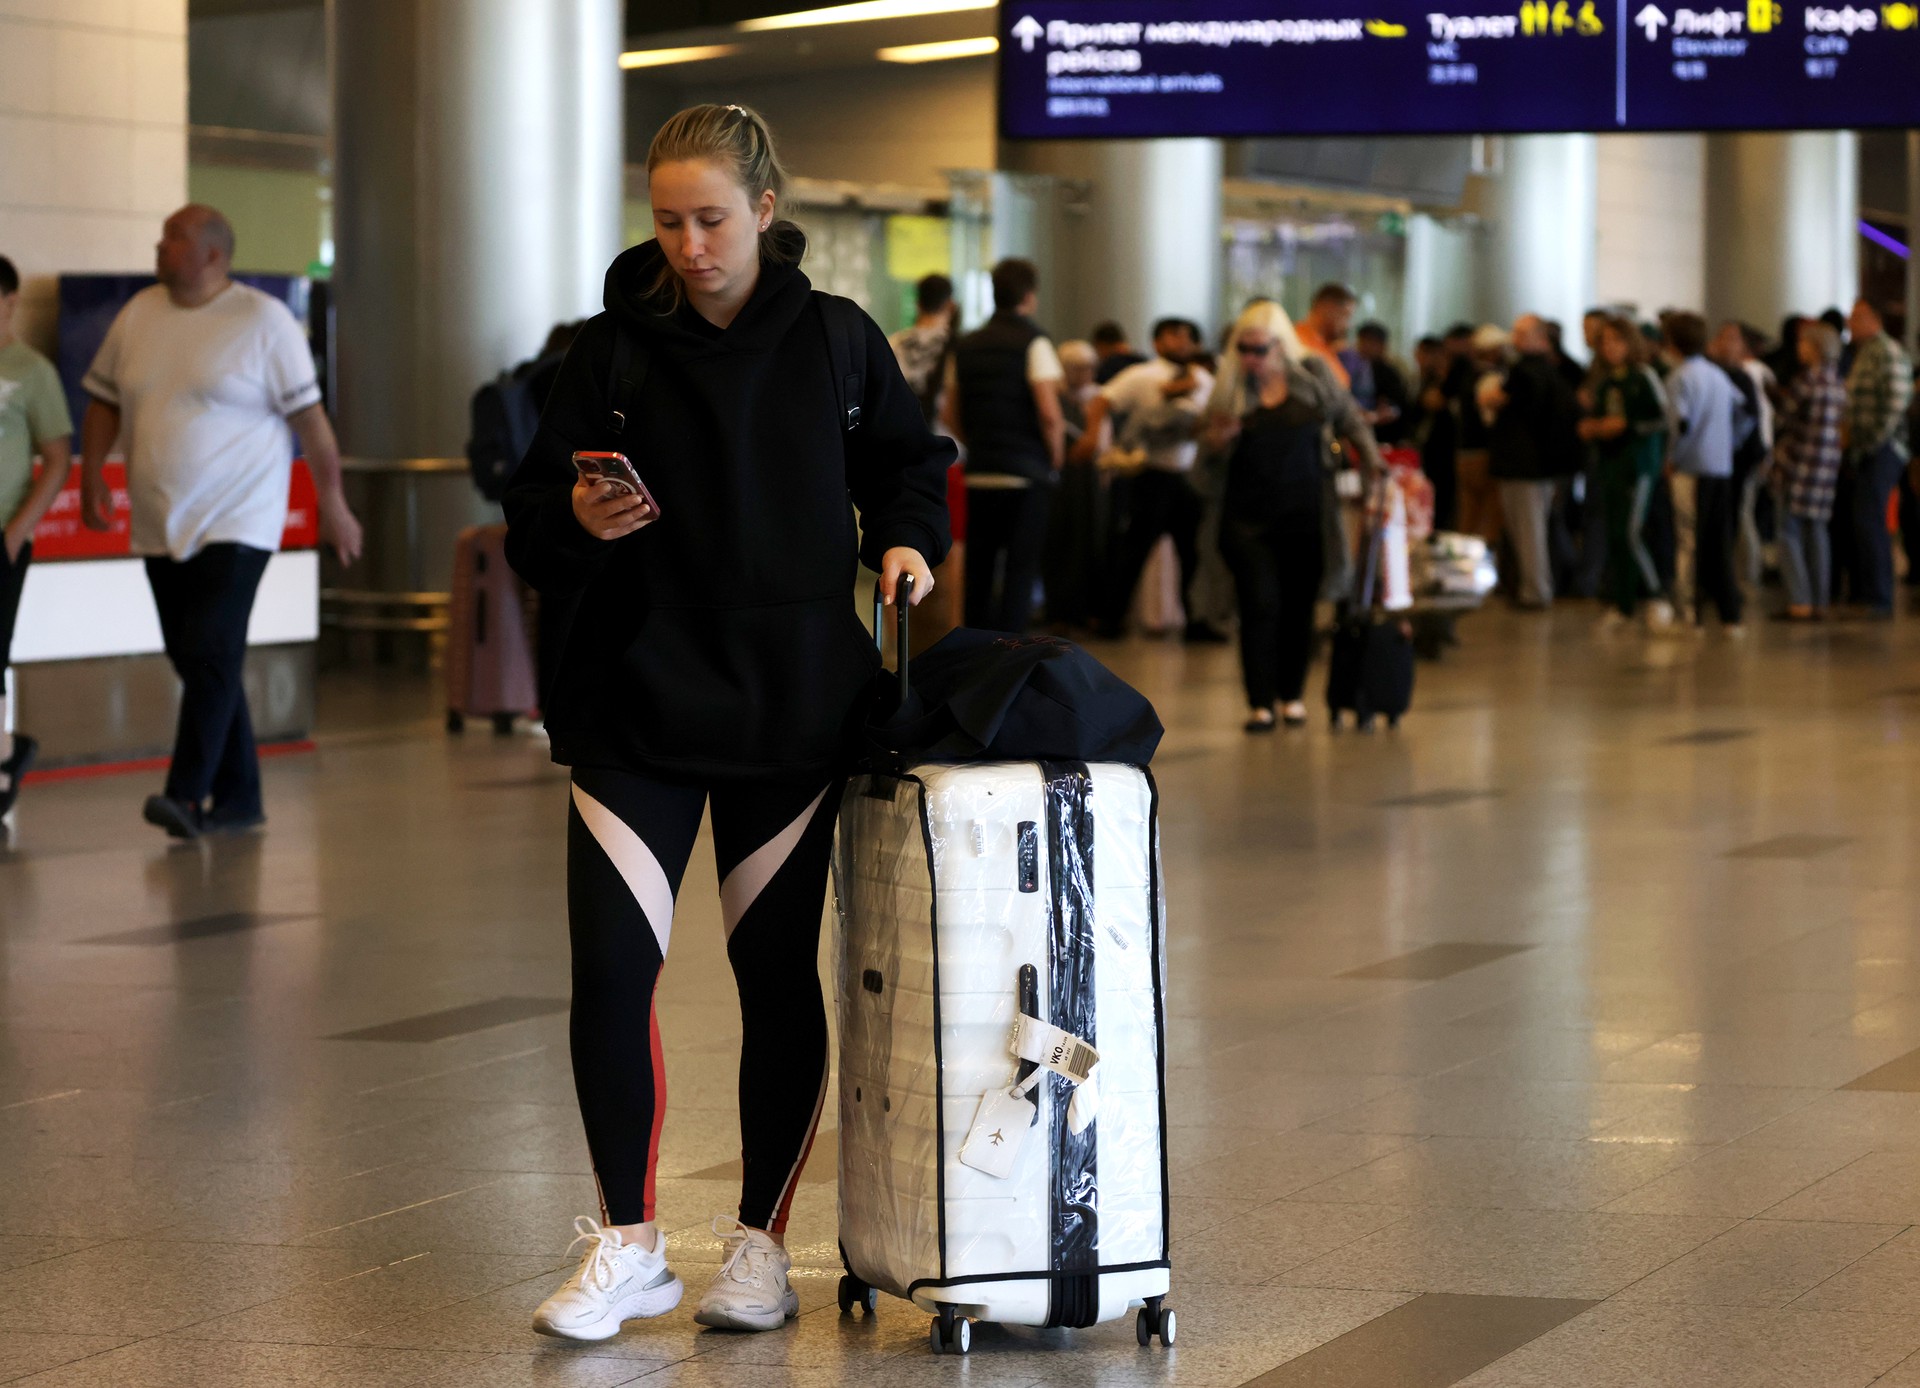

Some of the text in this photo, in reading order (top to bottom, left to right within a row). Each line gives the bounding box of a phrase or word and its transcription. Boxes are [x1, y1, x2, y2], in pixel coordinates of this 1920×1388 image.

[1426, 13, 1518, 42] Туалет
[1672, 8, 1744, 38] Лифт
[1805, 4, 1877, 35] Кафе
[1050, 1046, 1064, 1064] VKO
